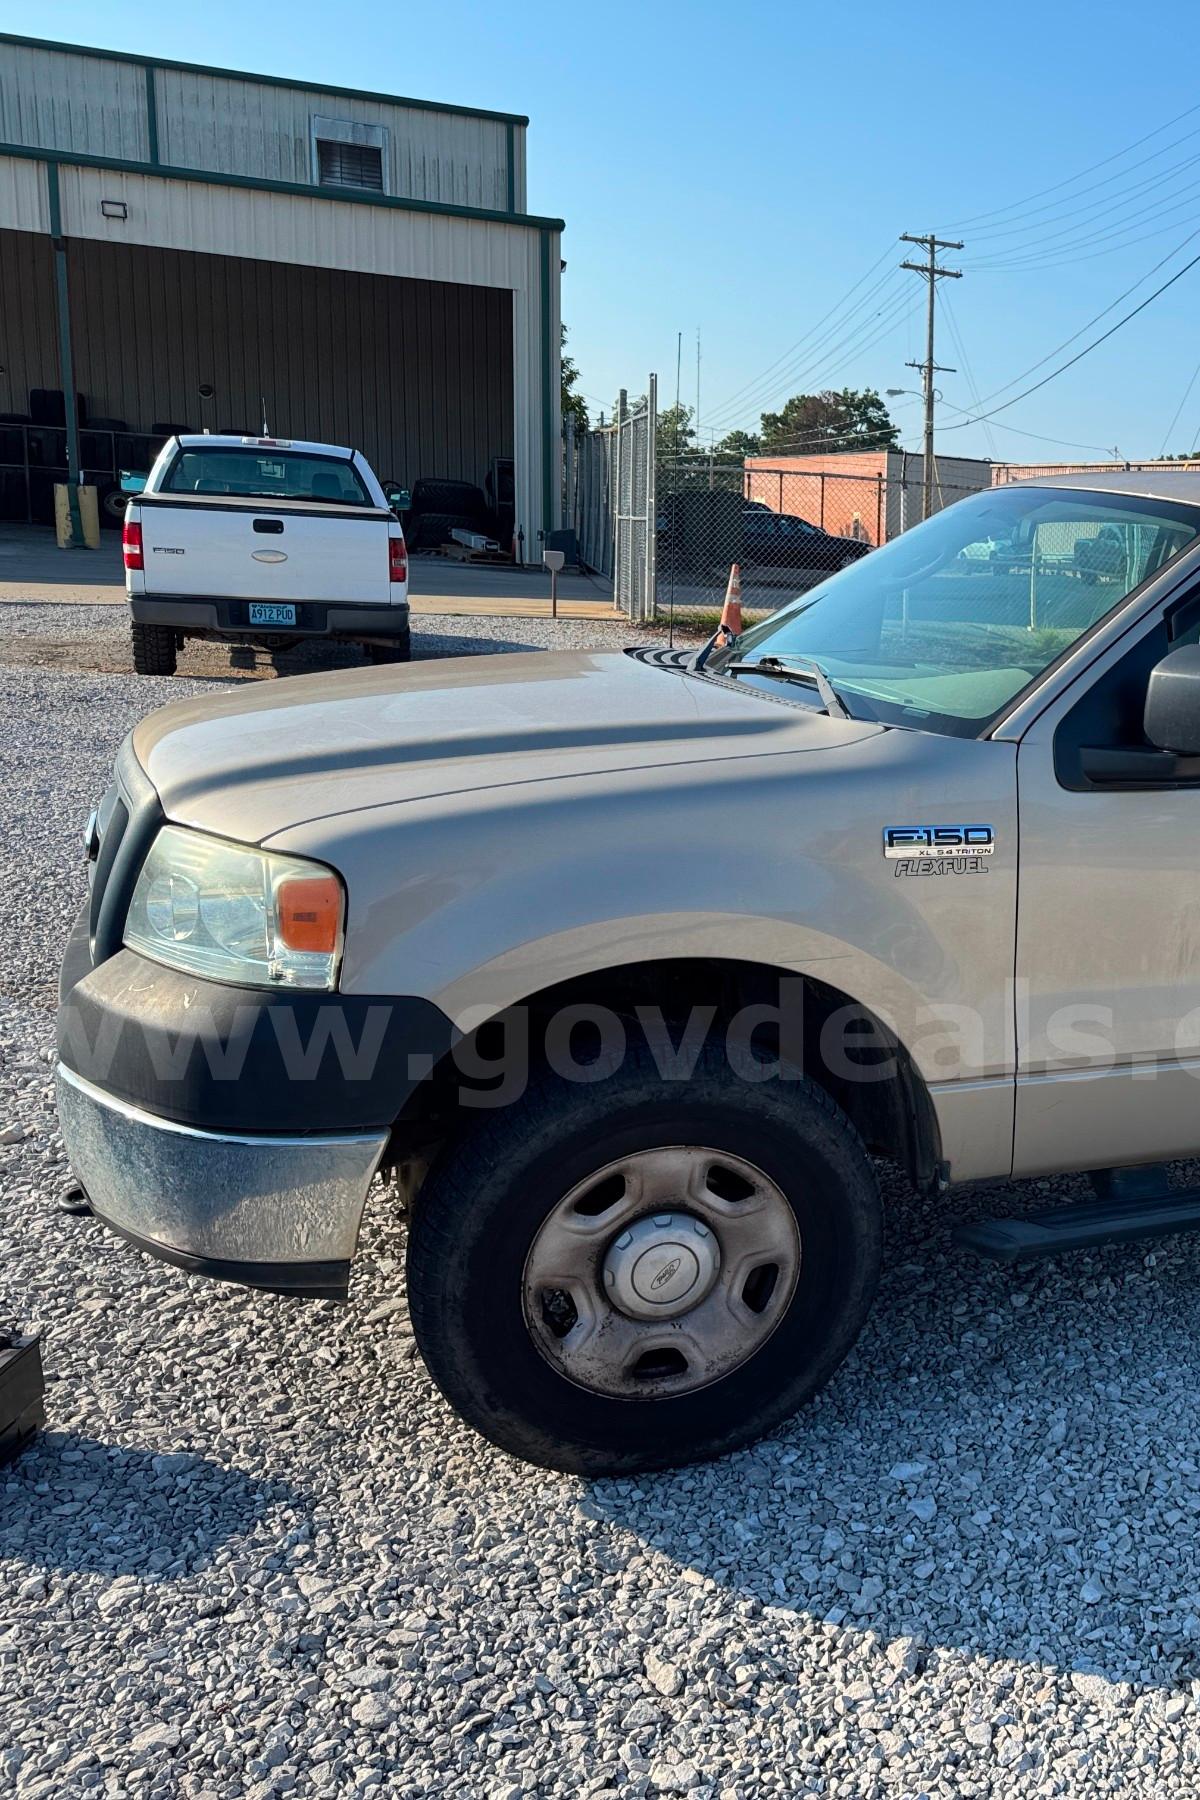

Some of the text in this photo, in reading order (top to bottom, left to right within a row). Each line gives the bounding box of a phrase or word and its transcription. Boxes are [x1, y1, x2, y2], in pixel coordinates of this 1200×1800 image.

[252, 608, 292, 620] A912 PUD
[887, 827, 992, 847] F-150
[895, 857, 989, 877] FLEXFUEL
